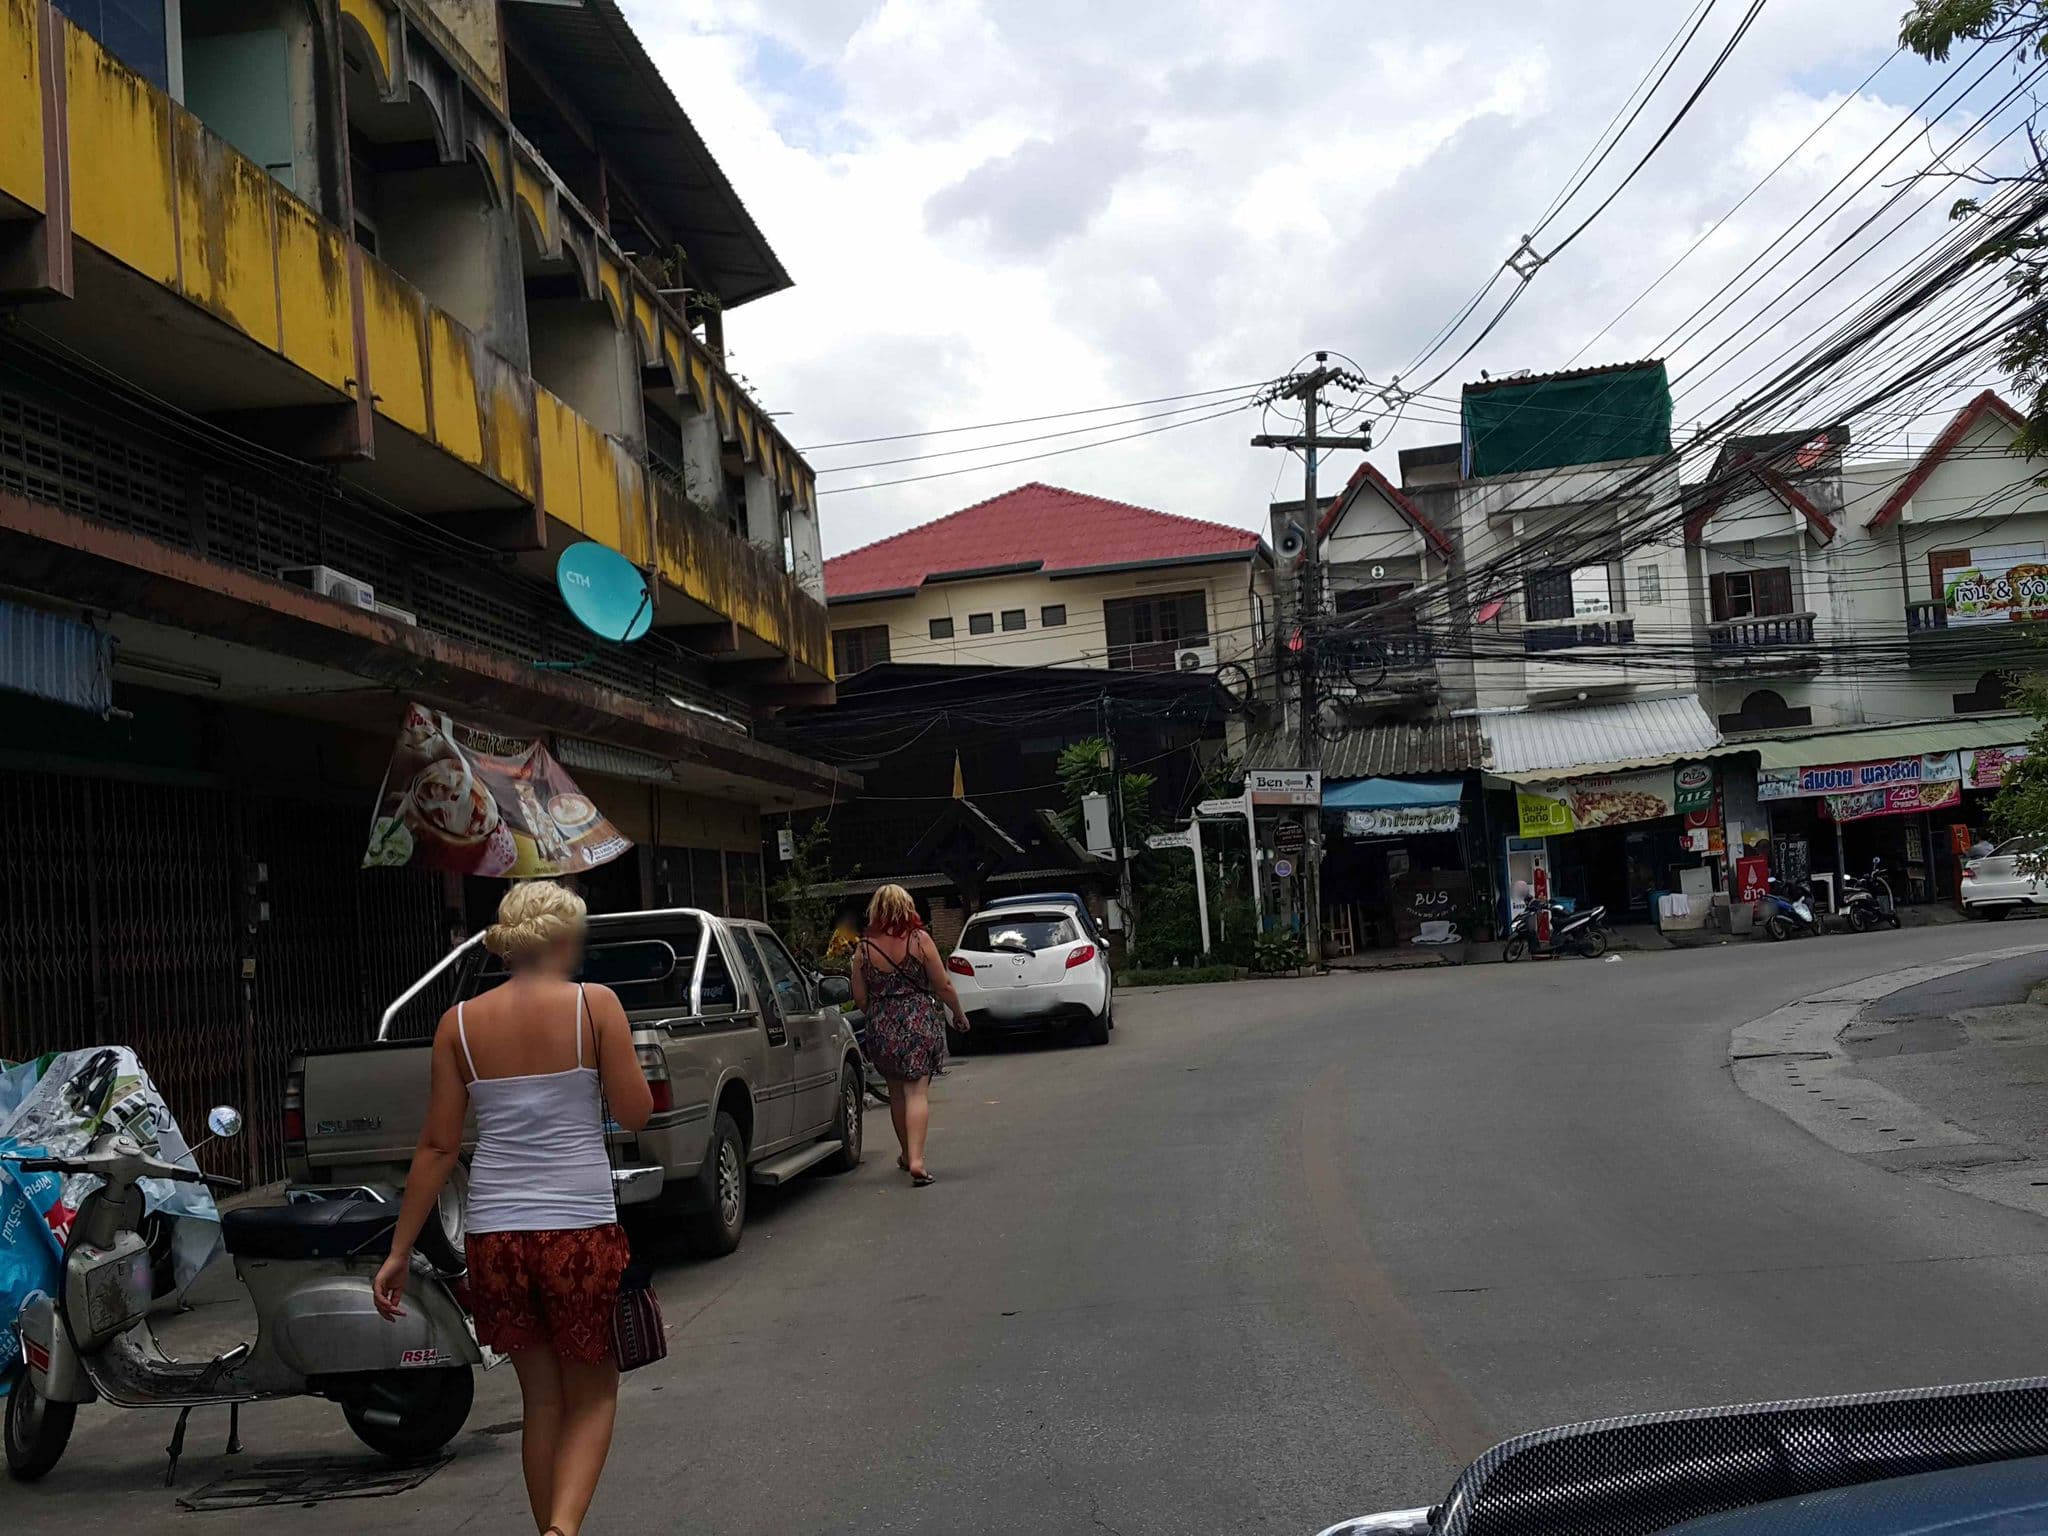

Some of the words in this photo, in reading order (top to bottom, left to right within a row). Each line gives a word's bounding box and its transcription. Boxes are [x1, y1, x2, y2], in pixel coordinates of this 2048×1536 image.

[566, 571, 590, 588] CTH
[1996, 580, 2012, 599] &
[1256, 776, 1283, 788] Ben
[1679, 790, 1712, 803] 1112
[1415, 890, 1449, 906] BUS
